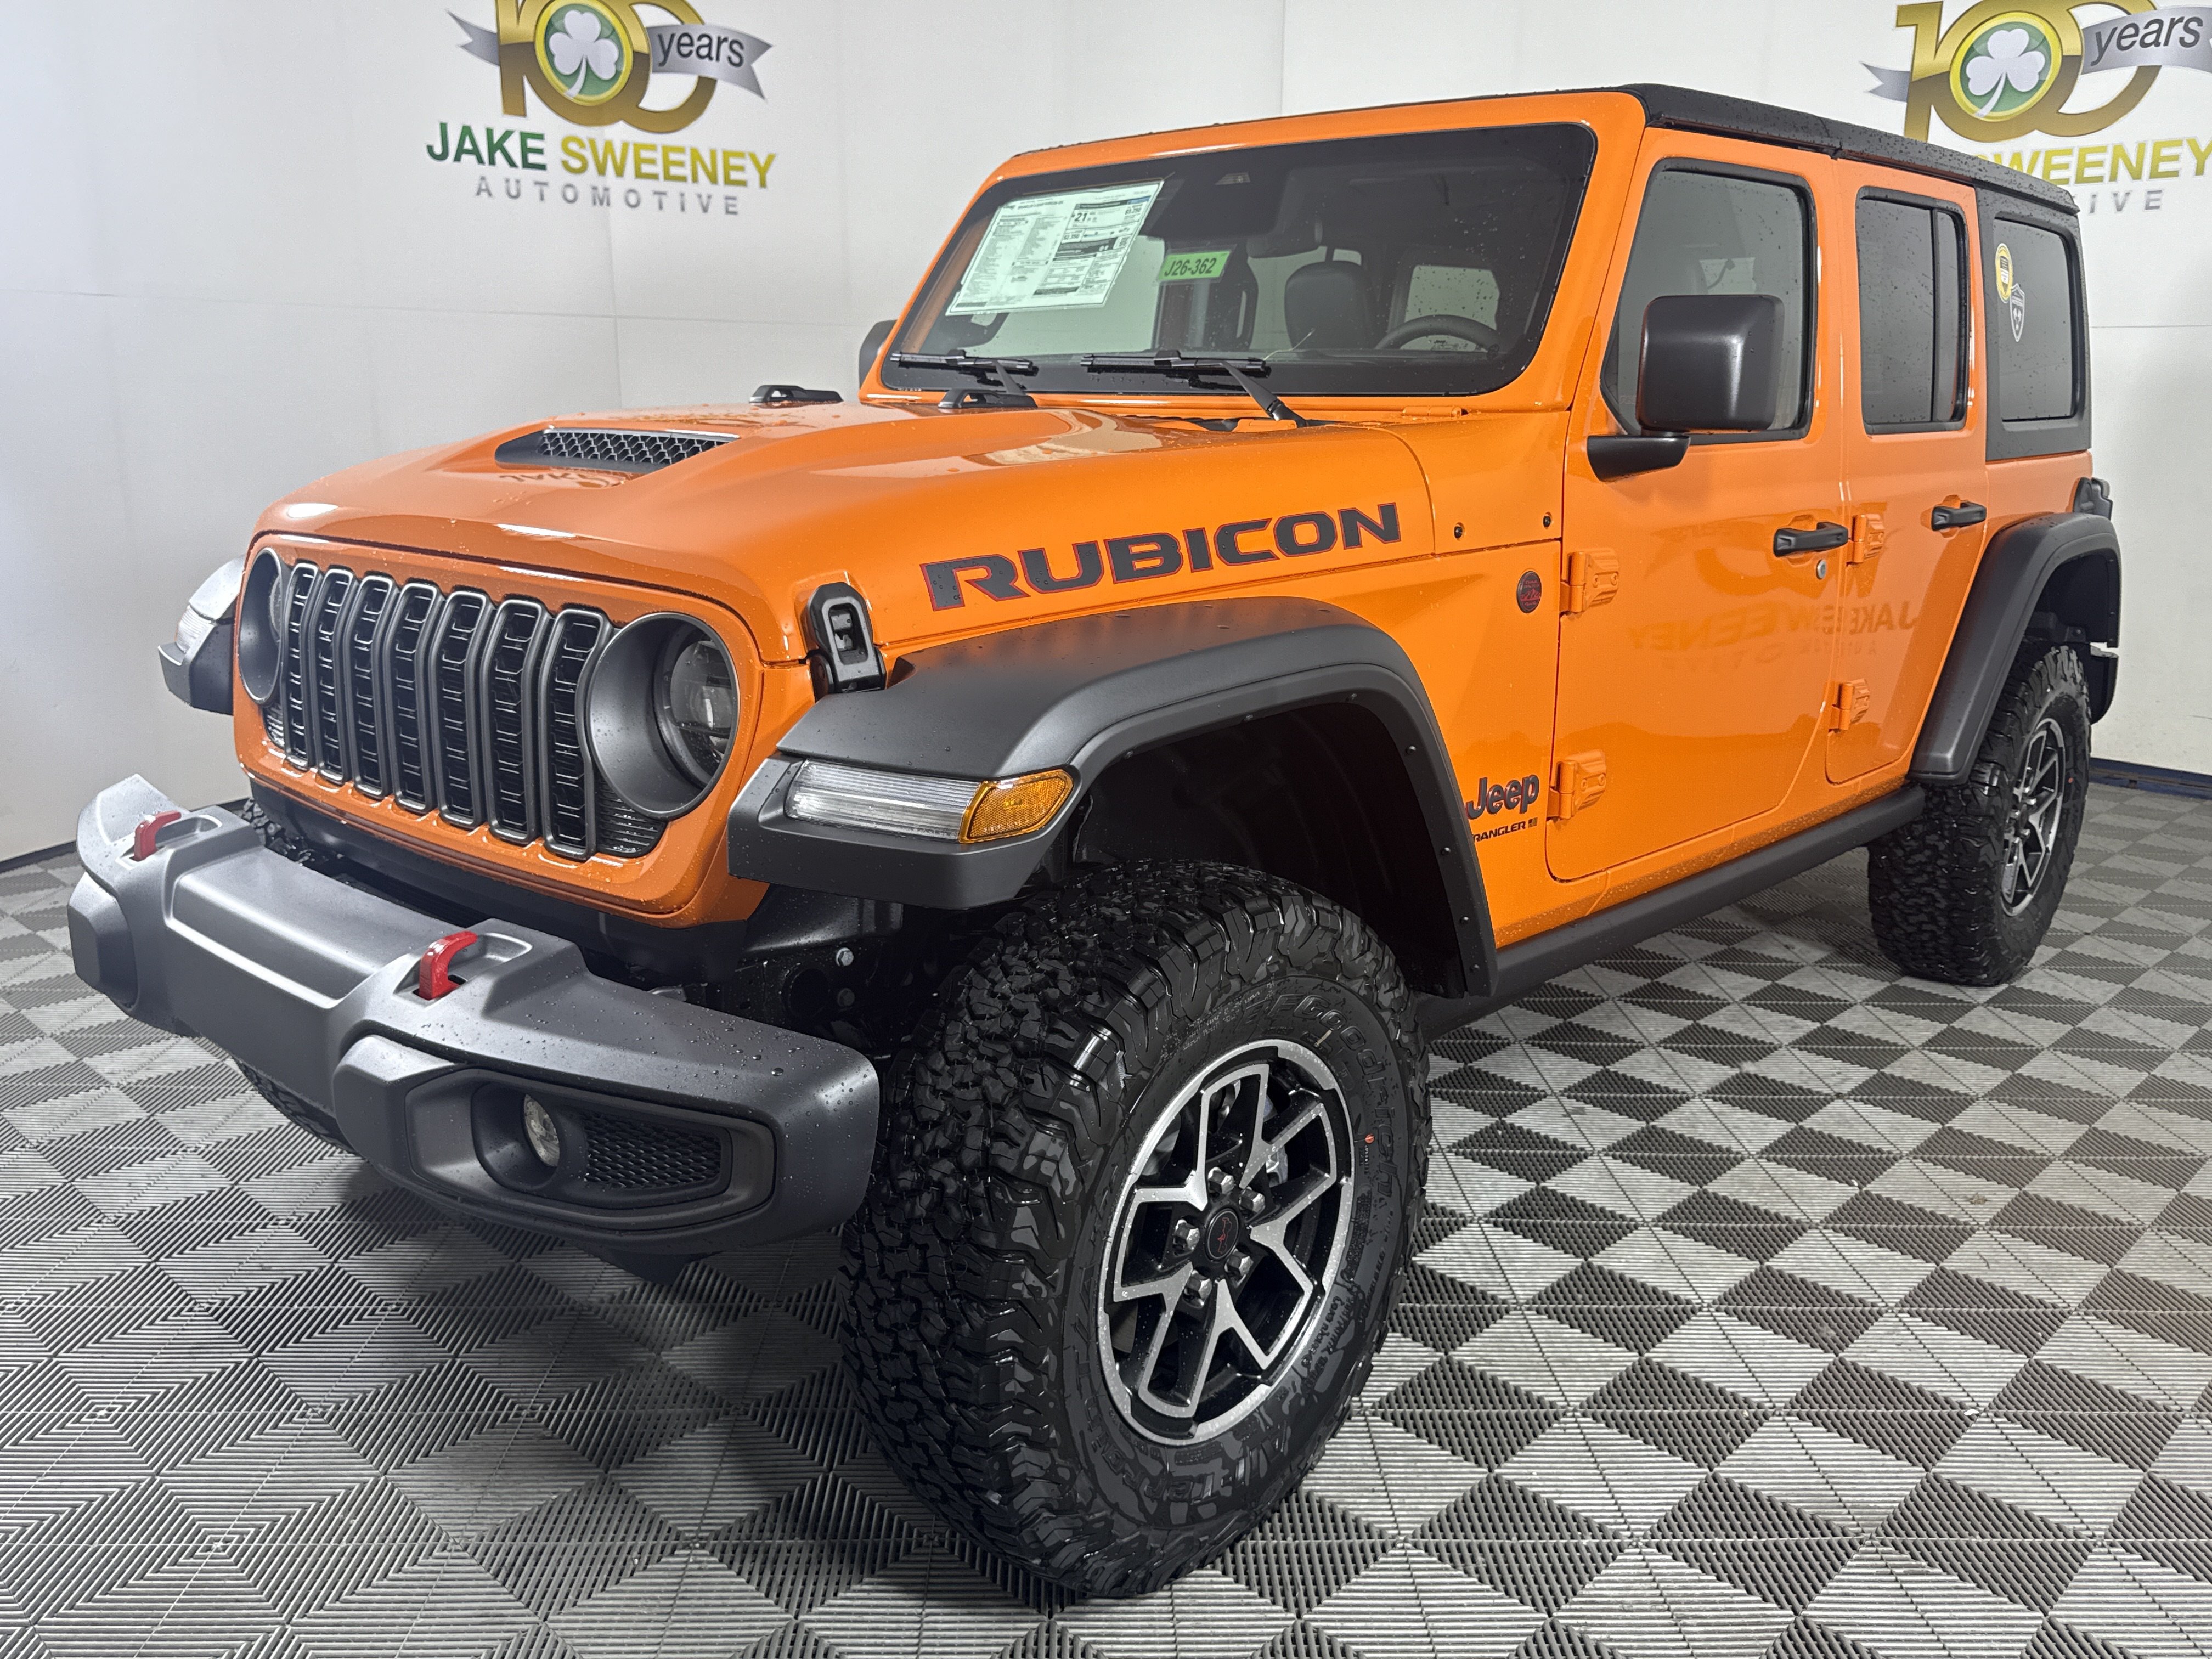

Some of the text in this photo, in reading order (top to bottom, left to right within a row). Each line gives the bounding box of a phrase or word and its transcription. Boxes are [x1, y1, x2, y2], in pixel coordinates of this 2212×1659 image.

[657, 29, 745, 67] years
[2090, 15, 2203, 66] years
[426, 122, 776, 188] JAKE SWEENEY
[1978, 137, 2212, 186] WEENEY
[476, 176, 739, 215] AUTOMOTIVE
[1074, 213, 1087, 222] 21
[1164, 258, 1217, 276] J26-362
[920, 502, 1401, 612] RUBICON
[1466, 774, 1539, 820] Jeep
[1472, 821, 1526, 842] RANGLER
[1241, 992, 1400, 1197] BFGoodrich
